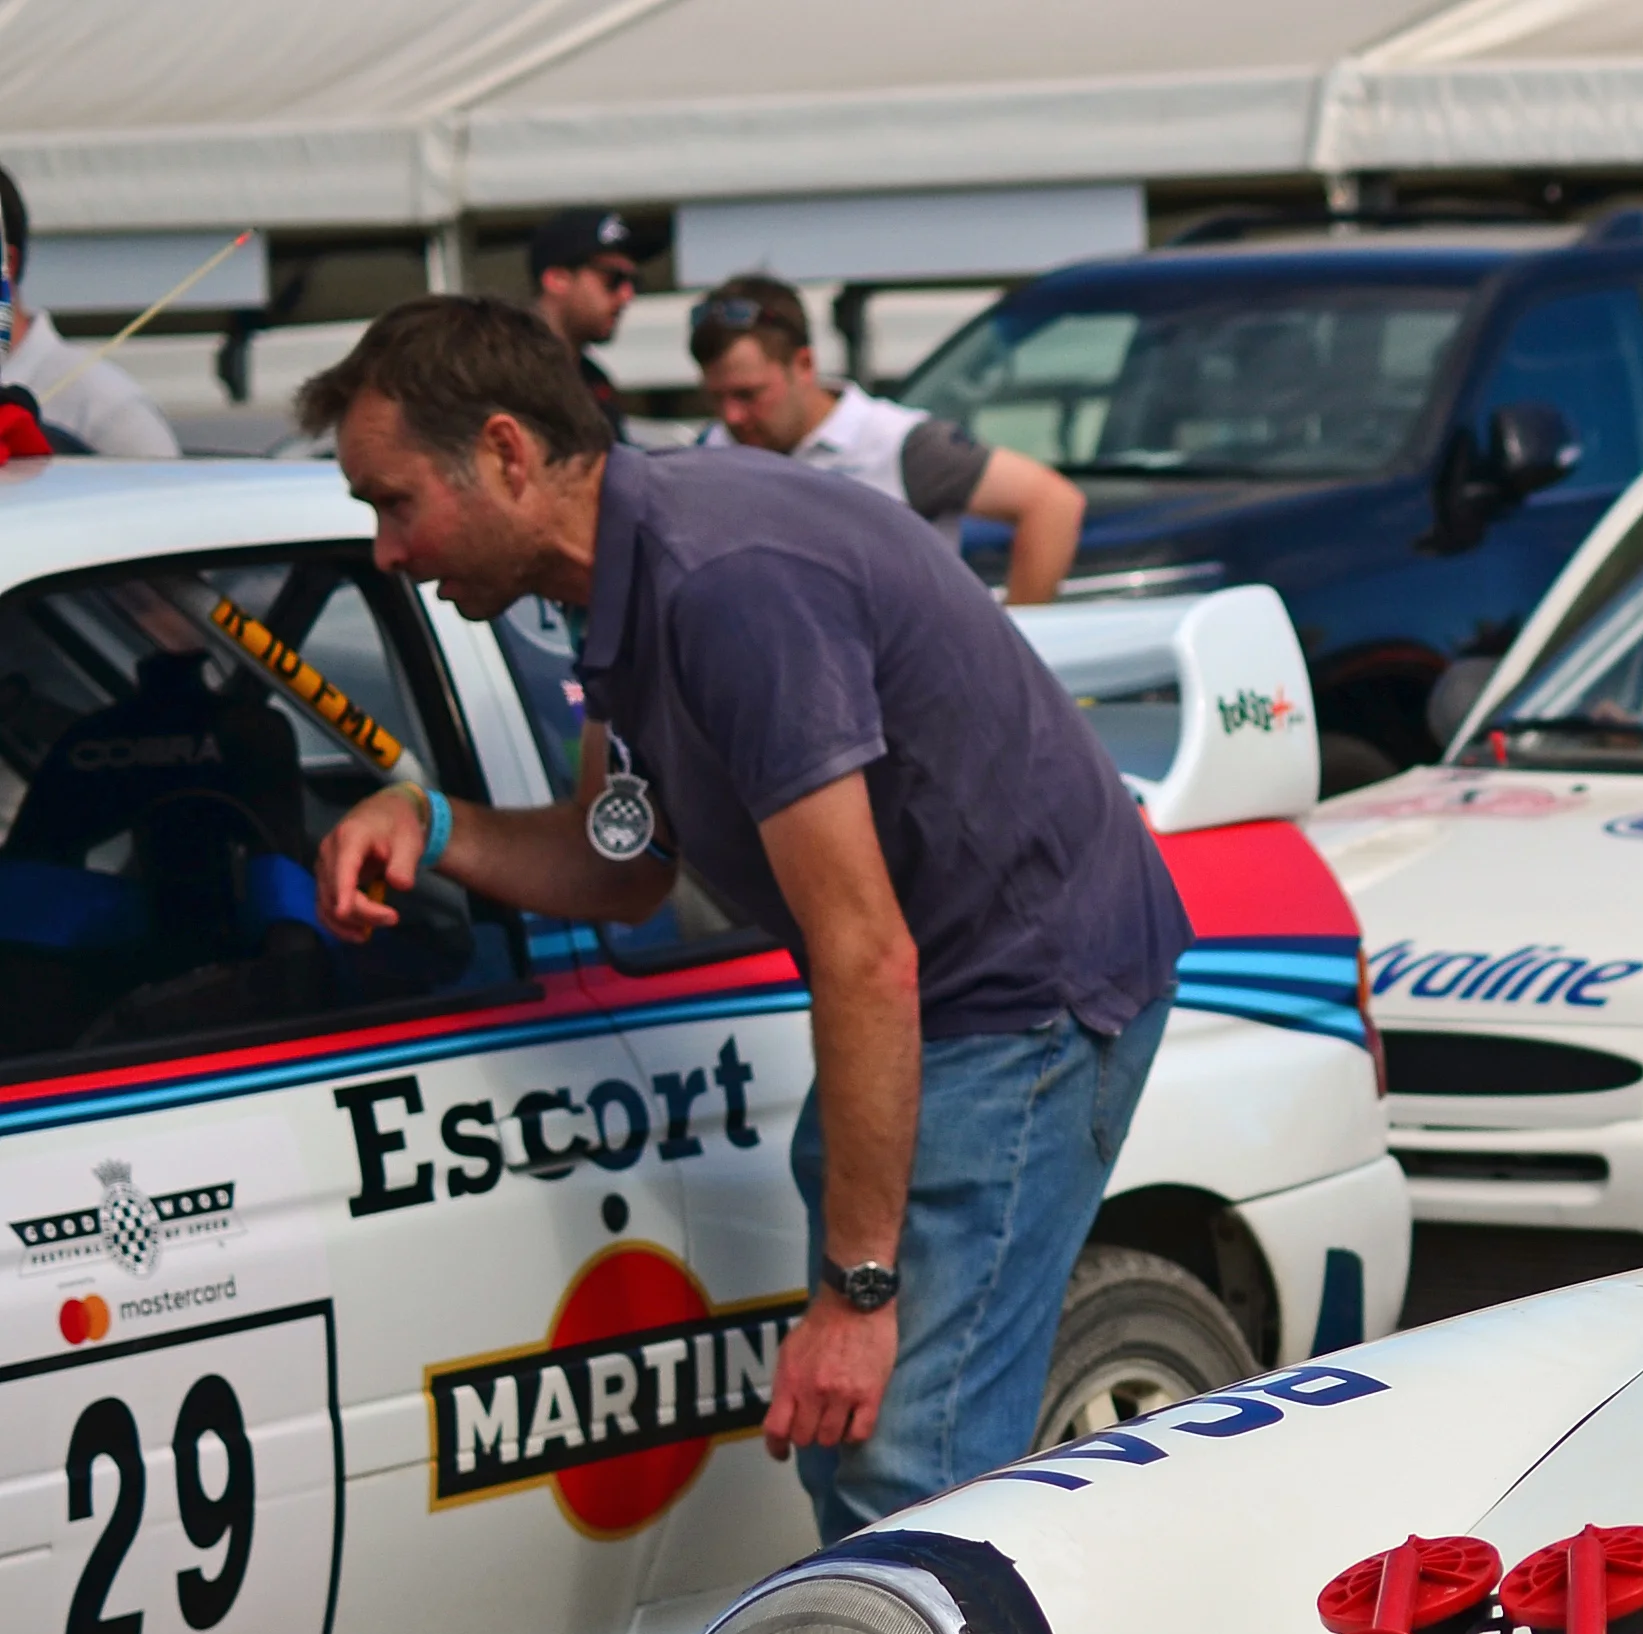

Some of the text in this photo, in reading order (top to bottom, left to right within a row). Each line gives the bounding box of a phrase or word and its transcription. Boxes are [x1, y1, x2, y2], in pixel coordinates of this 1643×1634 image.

[334, 1033, 761, 1218] Escort
[24, 1188, 230, 1243] GOOD WOOD
[120, 1273, 237, 1320] mastercard
[451, 1315, 802, 1475] MARTIN
